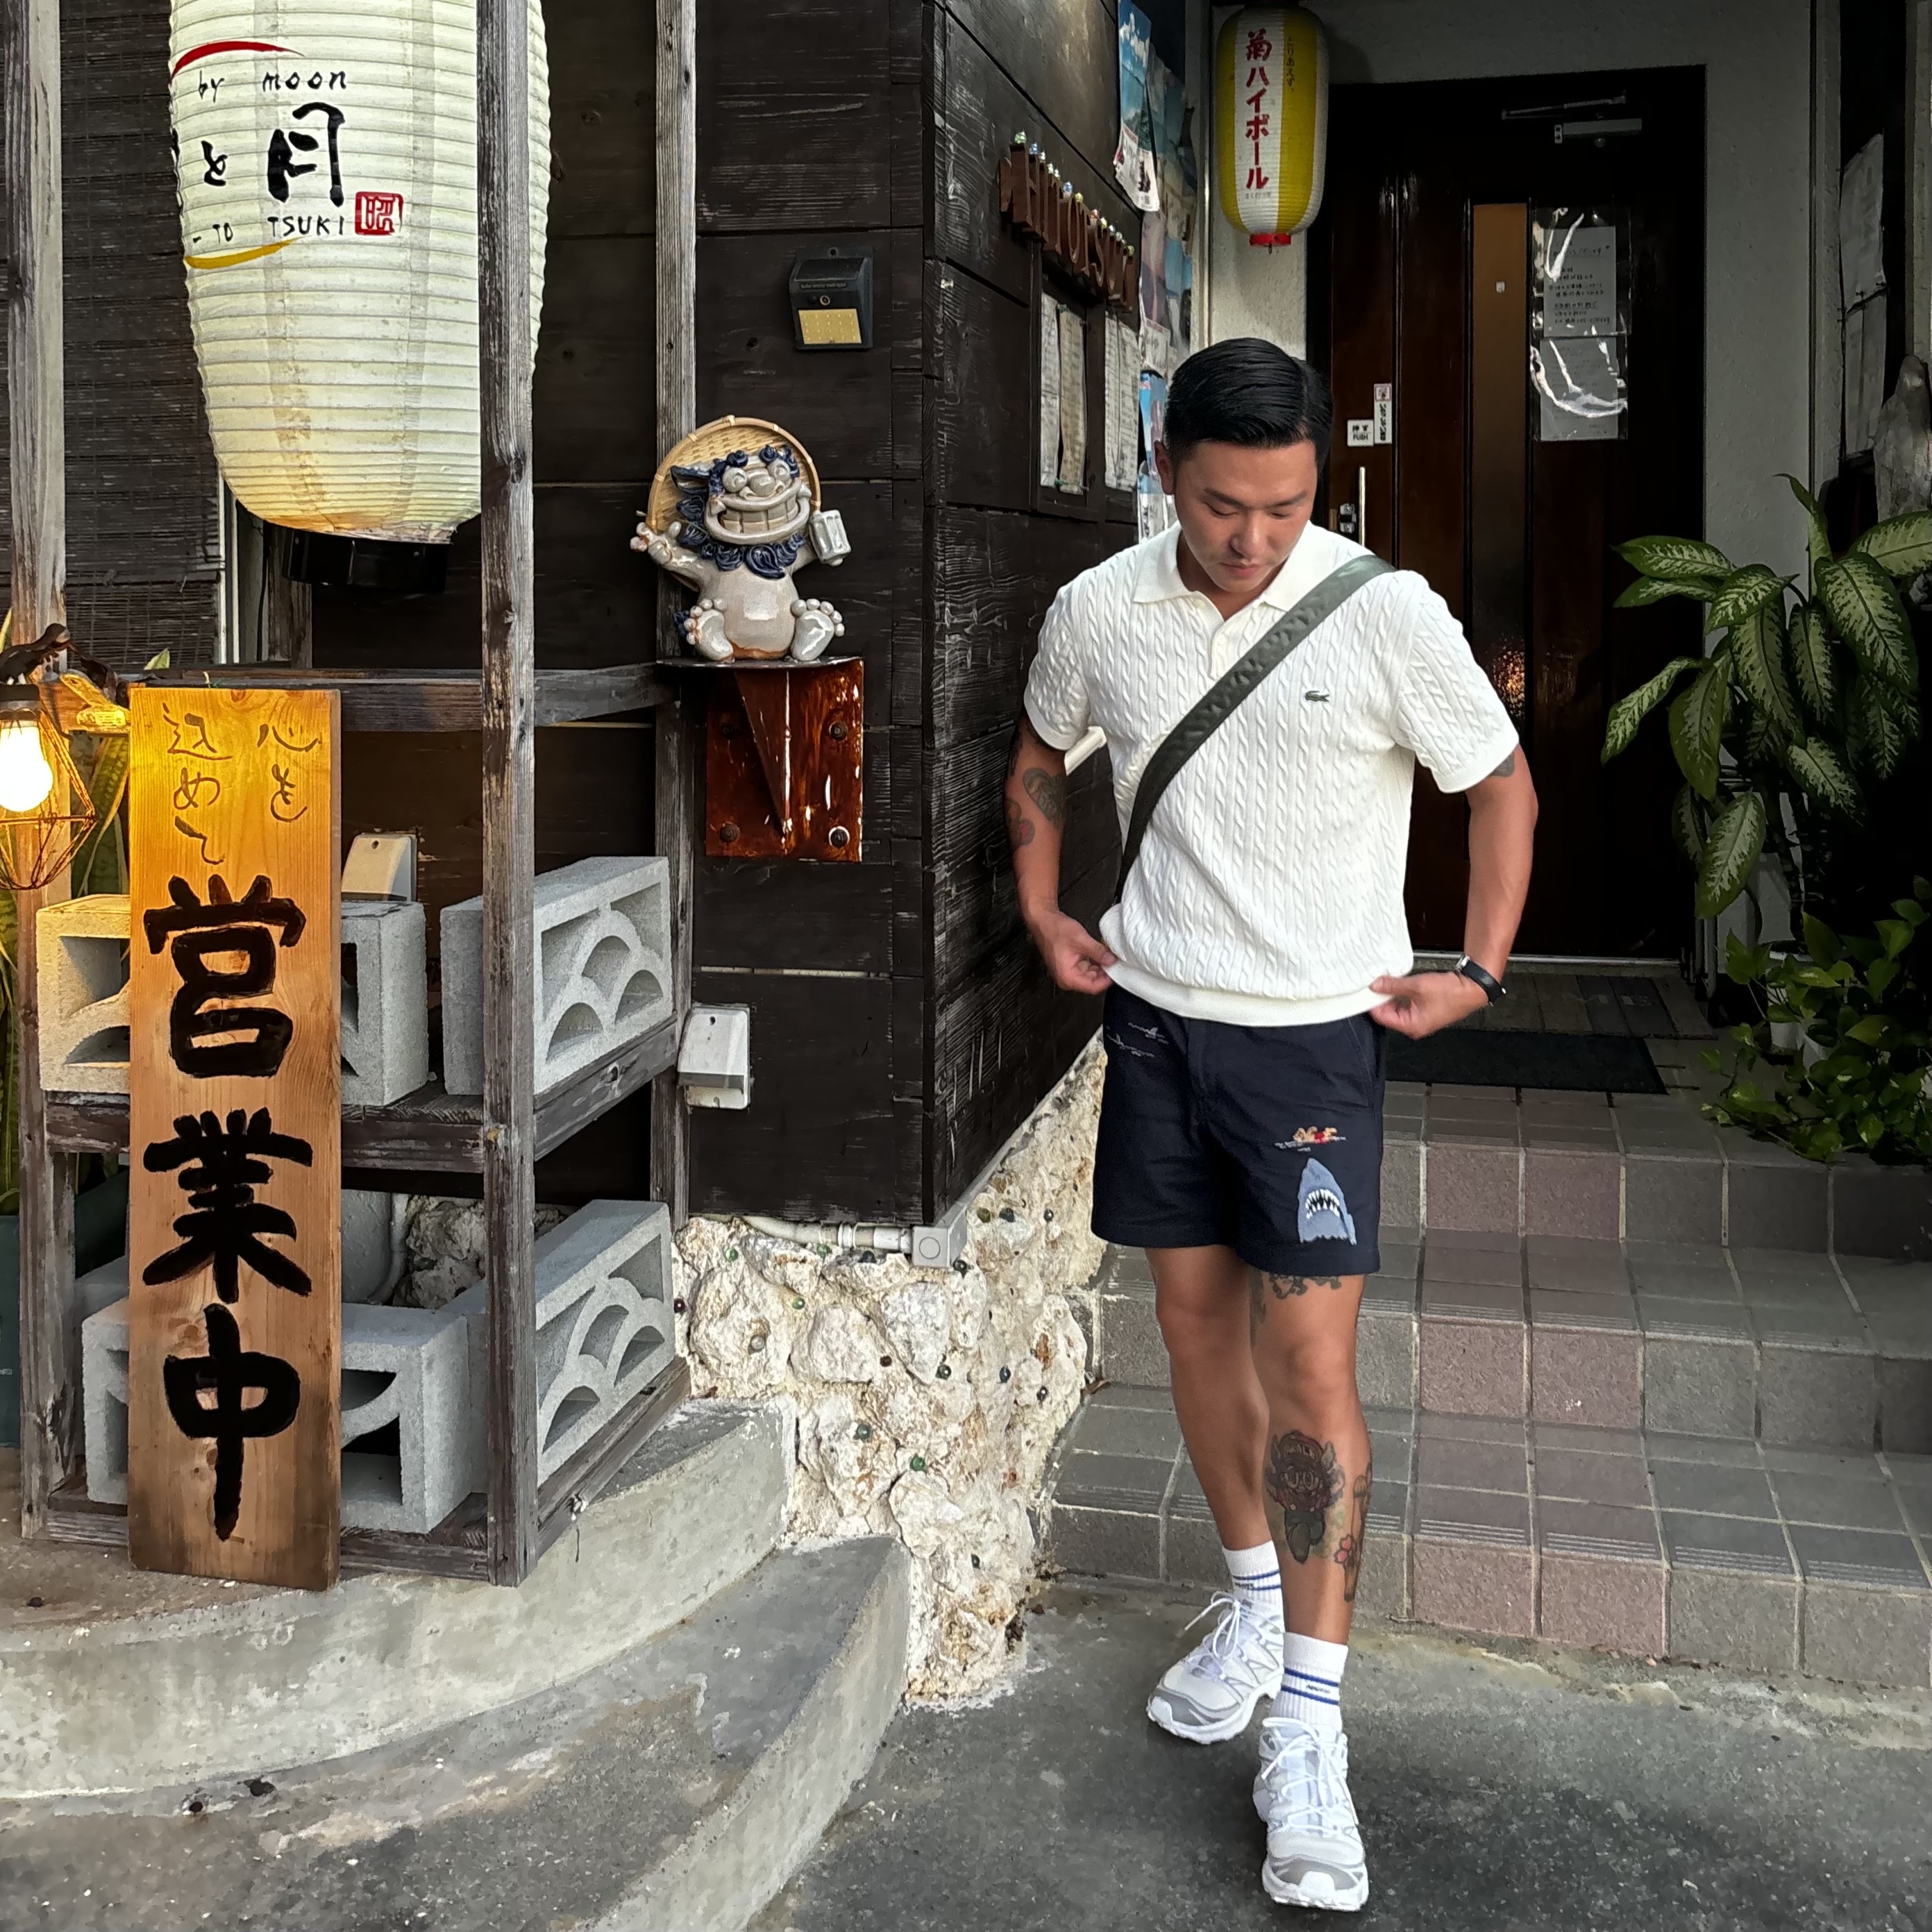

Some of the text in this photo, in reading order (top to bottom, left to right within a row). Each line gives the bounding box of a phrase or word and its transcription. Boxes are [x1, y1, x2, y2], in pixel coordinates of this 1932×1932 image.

[199, 70, 346, 103] by moon
[1245, 28, 1272, 189] 菊ハイボール
[267, 215, 344, 237] TSUKI
[143, 874, 312, 1541] 営業中
